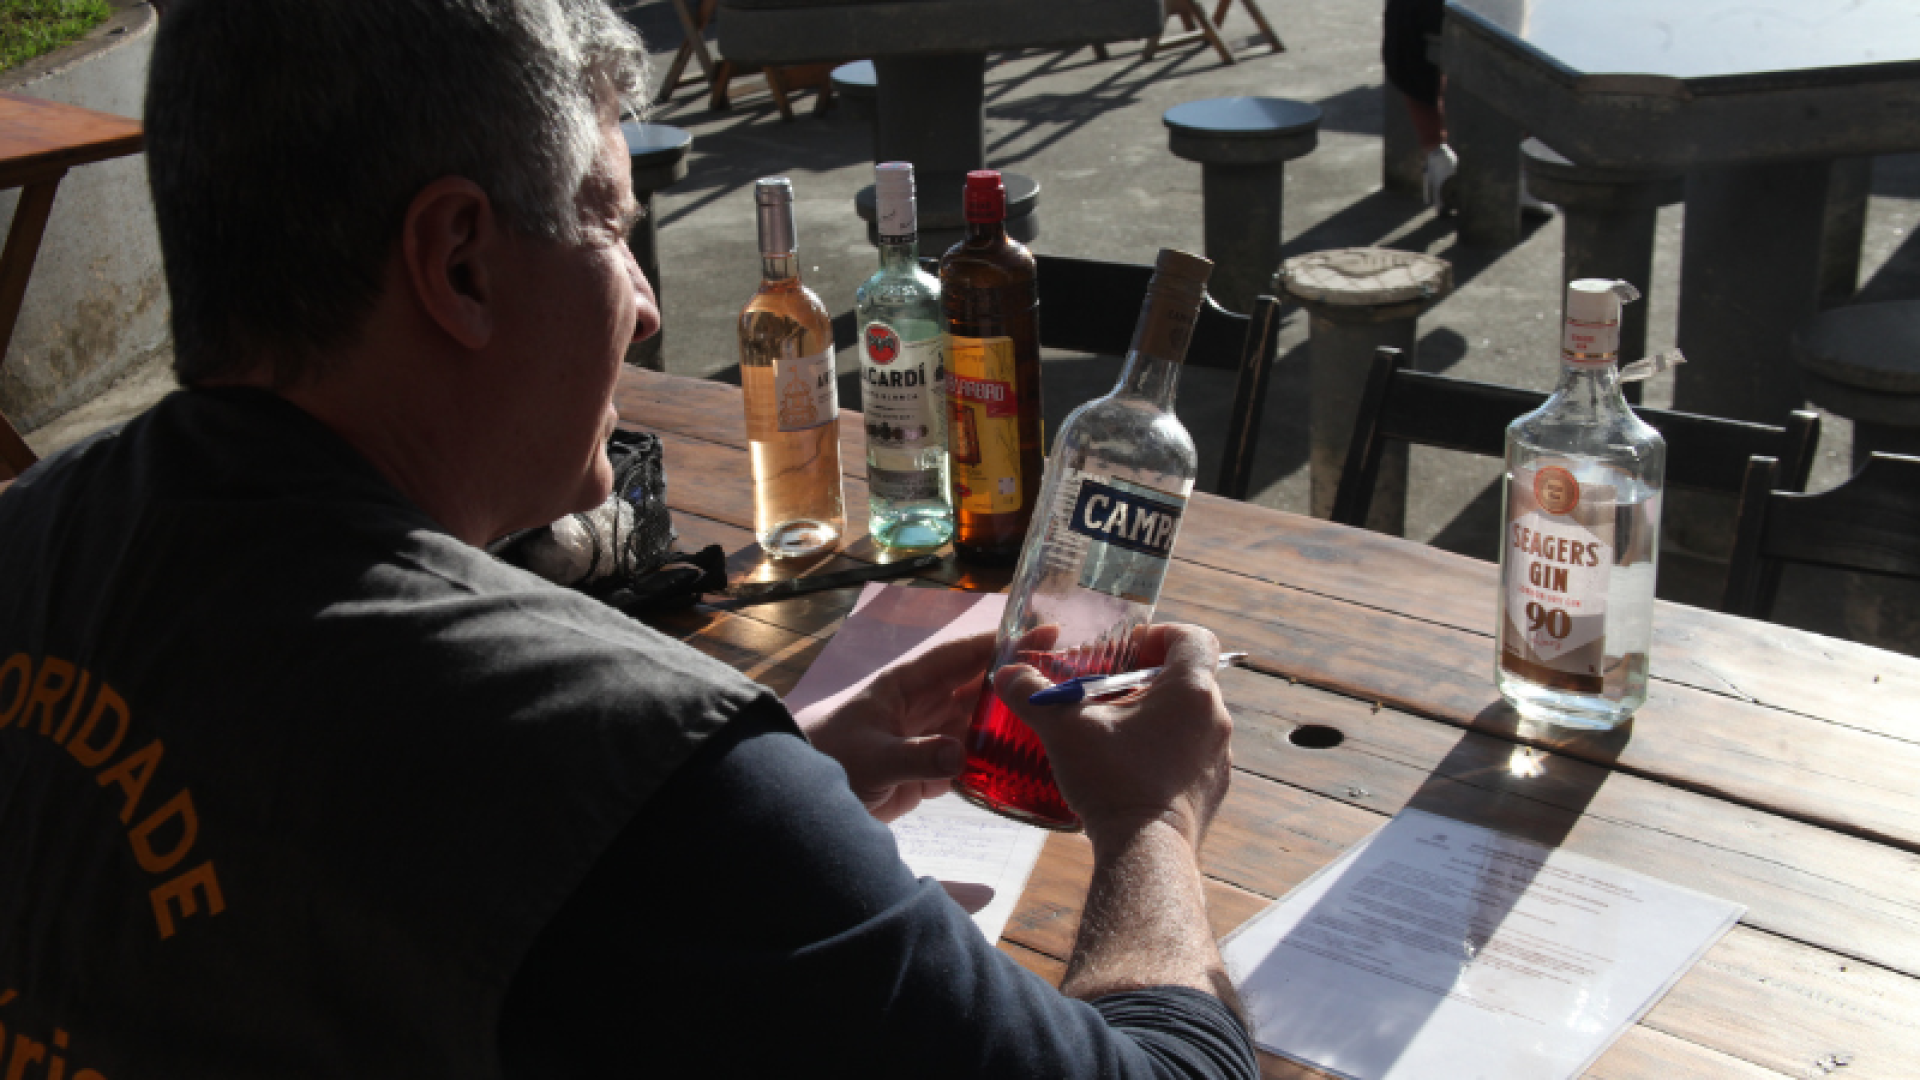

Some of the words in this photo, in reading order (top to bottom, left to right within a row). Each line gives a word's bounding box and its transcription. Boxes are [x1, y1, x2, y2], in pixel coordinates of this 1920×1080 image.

[1513, 522, 1601, 567] SEAGERS
[1529, 561, 1570, 593] GIN
[1526, 602, 1572, 639] 90
